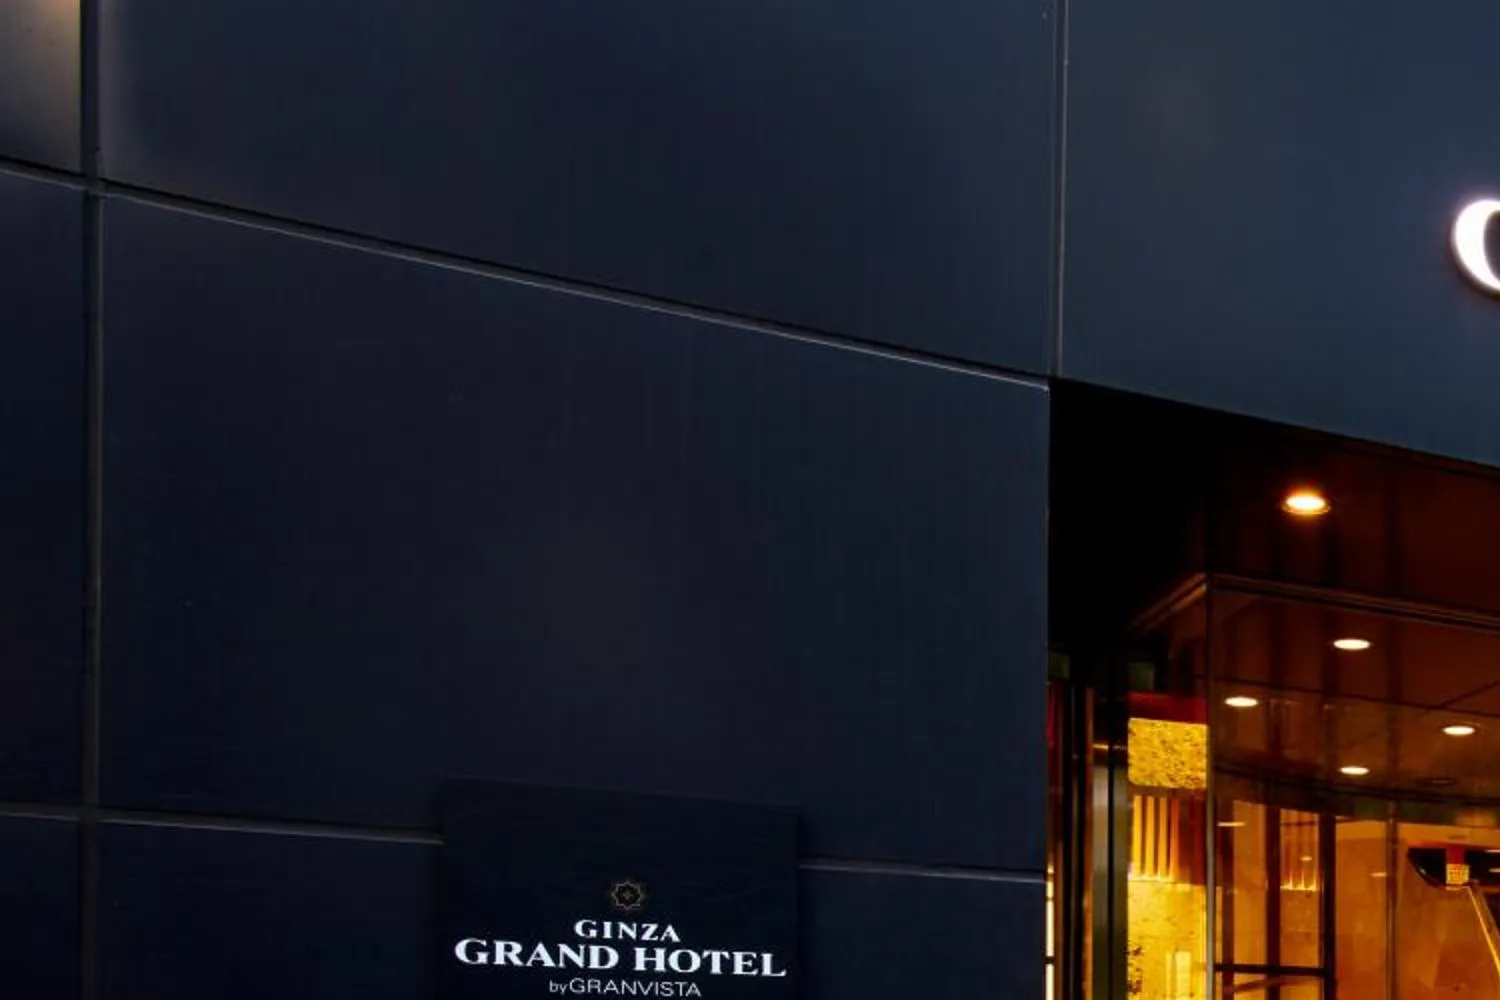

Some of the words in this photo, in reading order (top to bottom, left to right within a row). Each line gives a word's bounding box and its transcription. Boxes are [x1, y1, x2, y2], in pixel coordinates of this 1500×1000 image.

[573, 918, 681, 943] GINZA
[454, 937, 620, 970] GRAND
[633, 946, 787, 977] HOTEL
